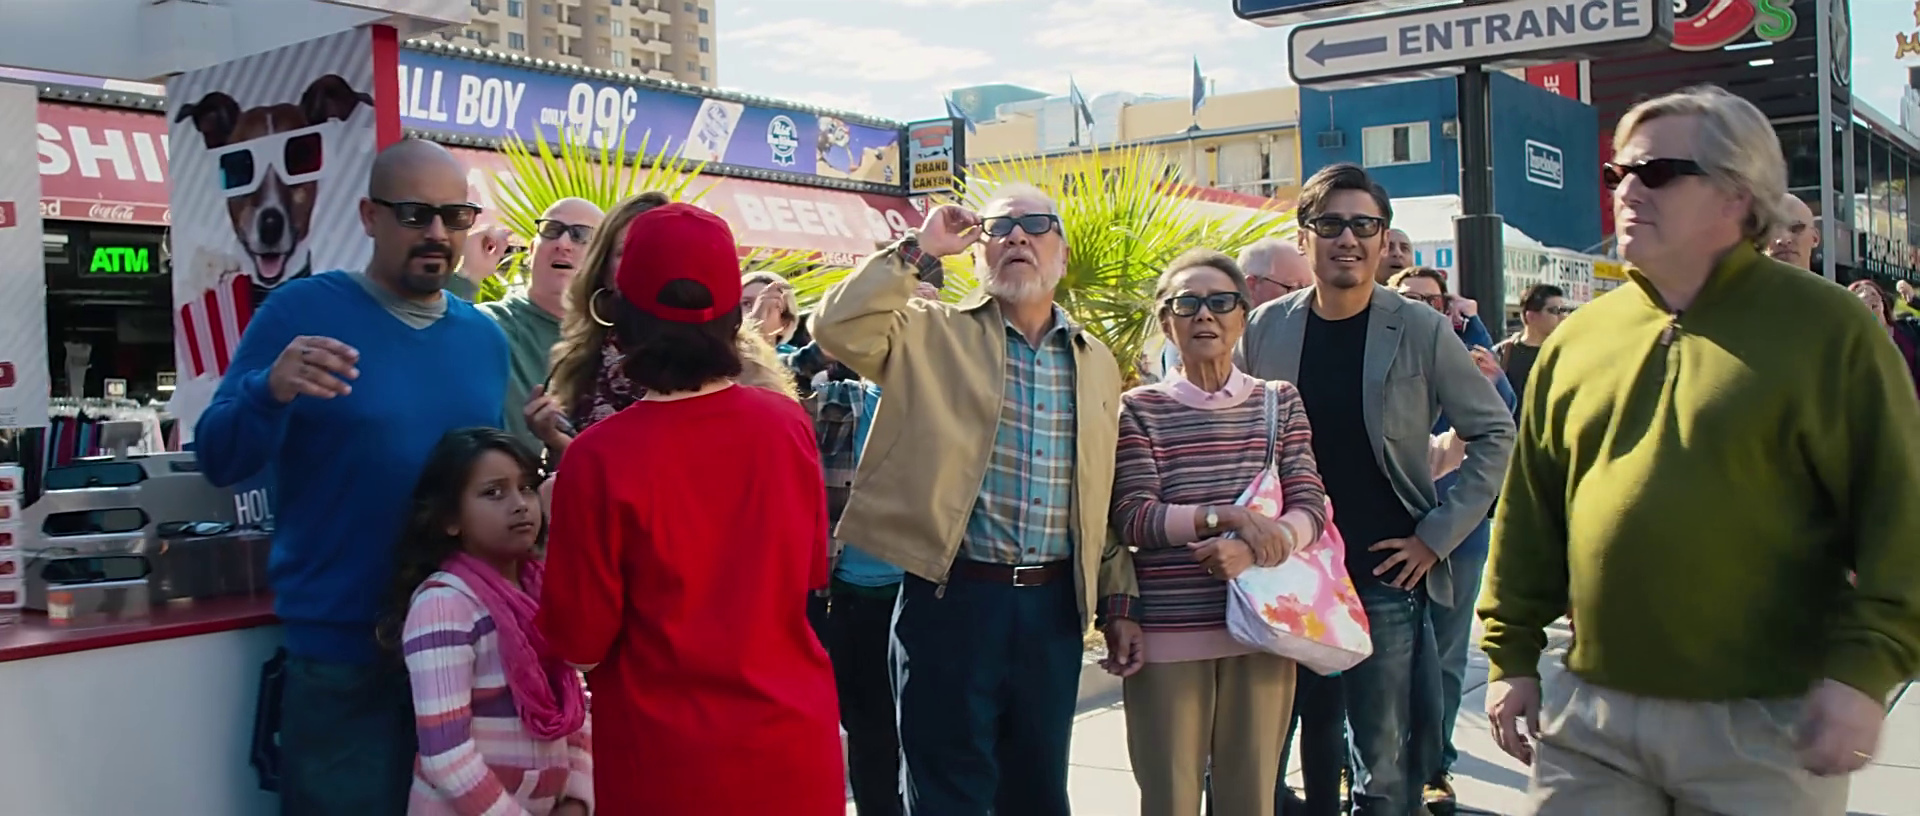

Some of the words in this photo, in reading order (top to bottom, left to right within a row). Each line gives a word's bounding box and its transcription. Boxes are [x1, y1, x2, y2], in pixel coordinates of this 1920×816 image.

[1398, 0, 1640, 56] ENTRANCE
[456, 74, 526, 130] BOY
[37, 122, 169, 182] SHI
[915, 161, 949, 175] GRAND
[912, 175, 952, 189] CANYON
[733, 193, 854, 239] BEER
[90, 247, 149, 272] ATM
[1559, 259, 1590, 284] SHIRTS
